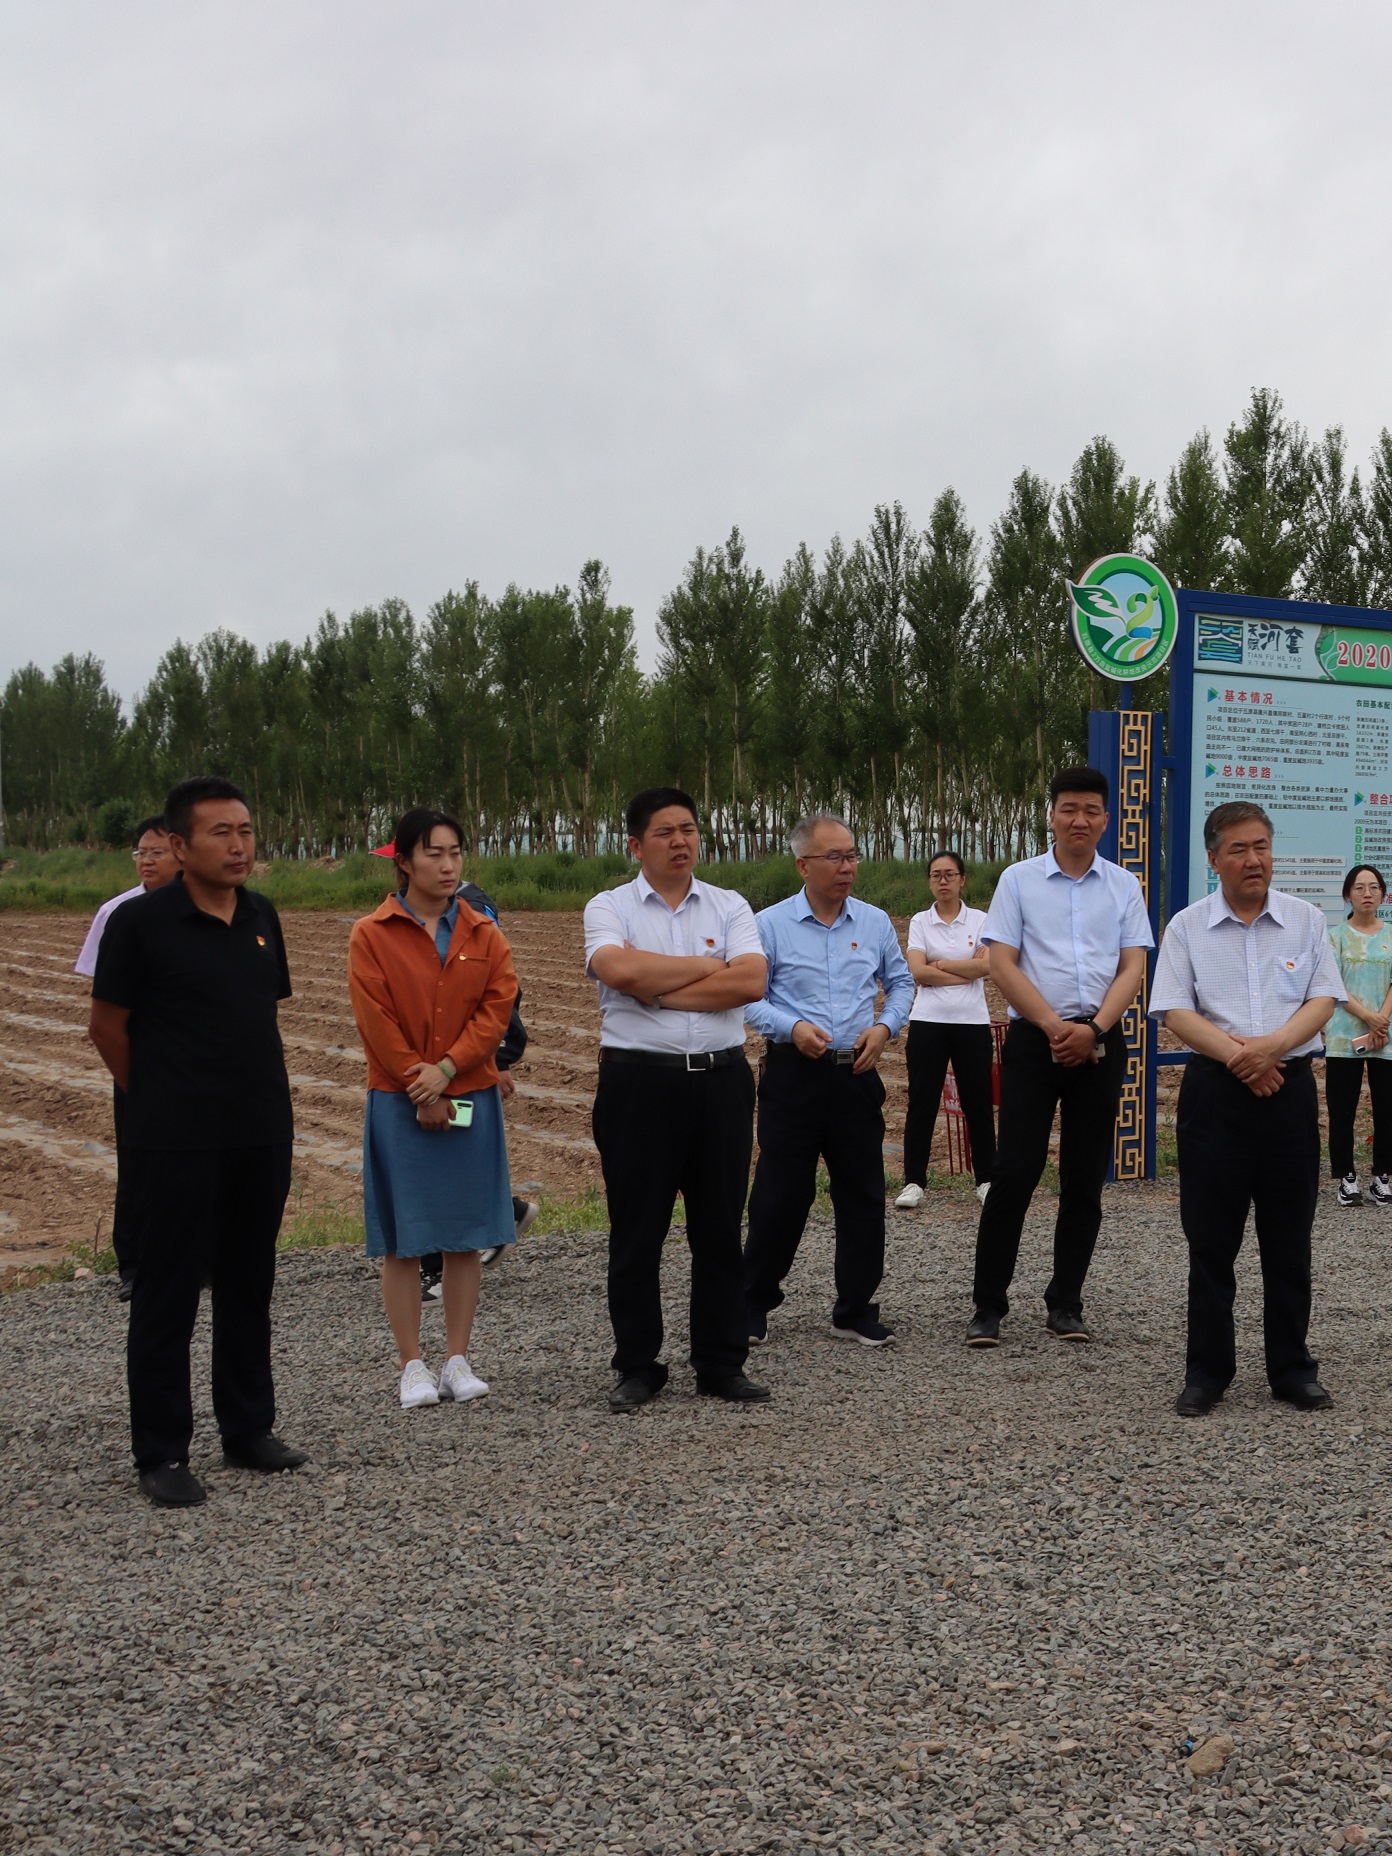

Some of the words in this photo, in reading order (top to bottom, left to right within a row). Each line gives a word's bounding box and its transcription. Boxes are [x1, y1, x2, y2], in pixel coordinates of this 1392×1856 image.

[1289, 655, 1302, 663] TAO
[1224, 689, 1274, 705] 基本情况
[1222, 765, 1272, 779] 总体思路
